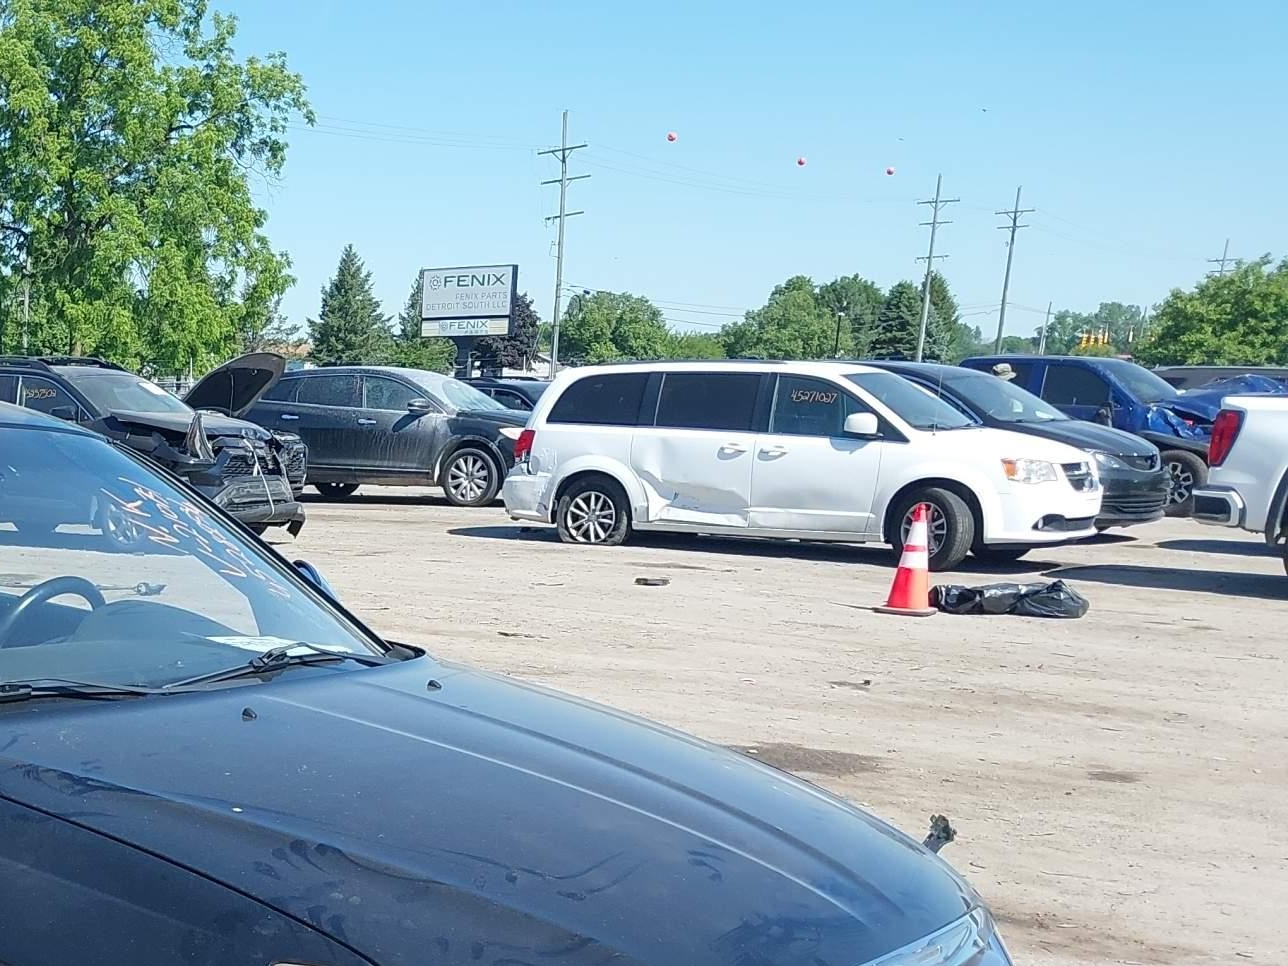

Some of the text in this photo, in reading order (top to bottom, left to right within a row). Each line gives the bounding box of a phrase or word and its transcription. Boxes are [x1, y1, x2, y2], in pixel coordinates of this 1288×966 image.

[443, 273, 506, 288] FENIX
[455, 291, 508, 300] FENIX PARTS
[426, 302, 460, 311] DETROIT
[462, 301, 490, 310] SOUTH
[449, 320, 489, 330] FENIX
